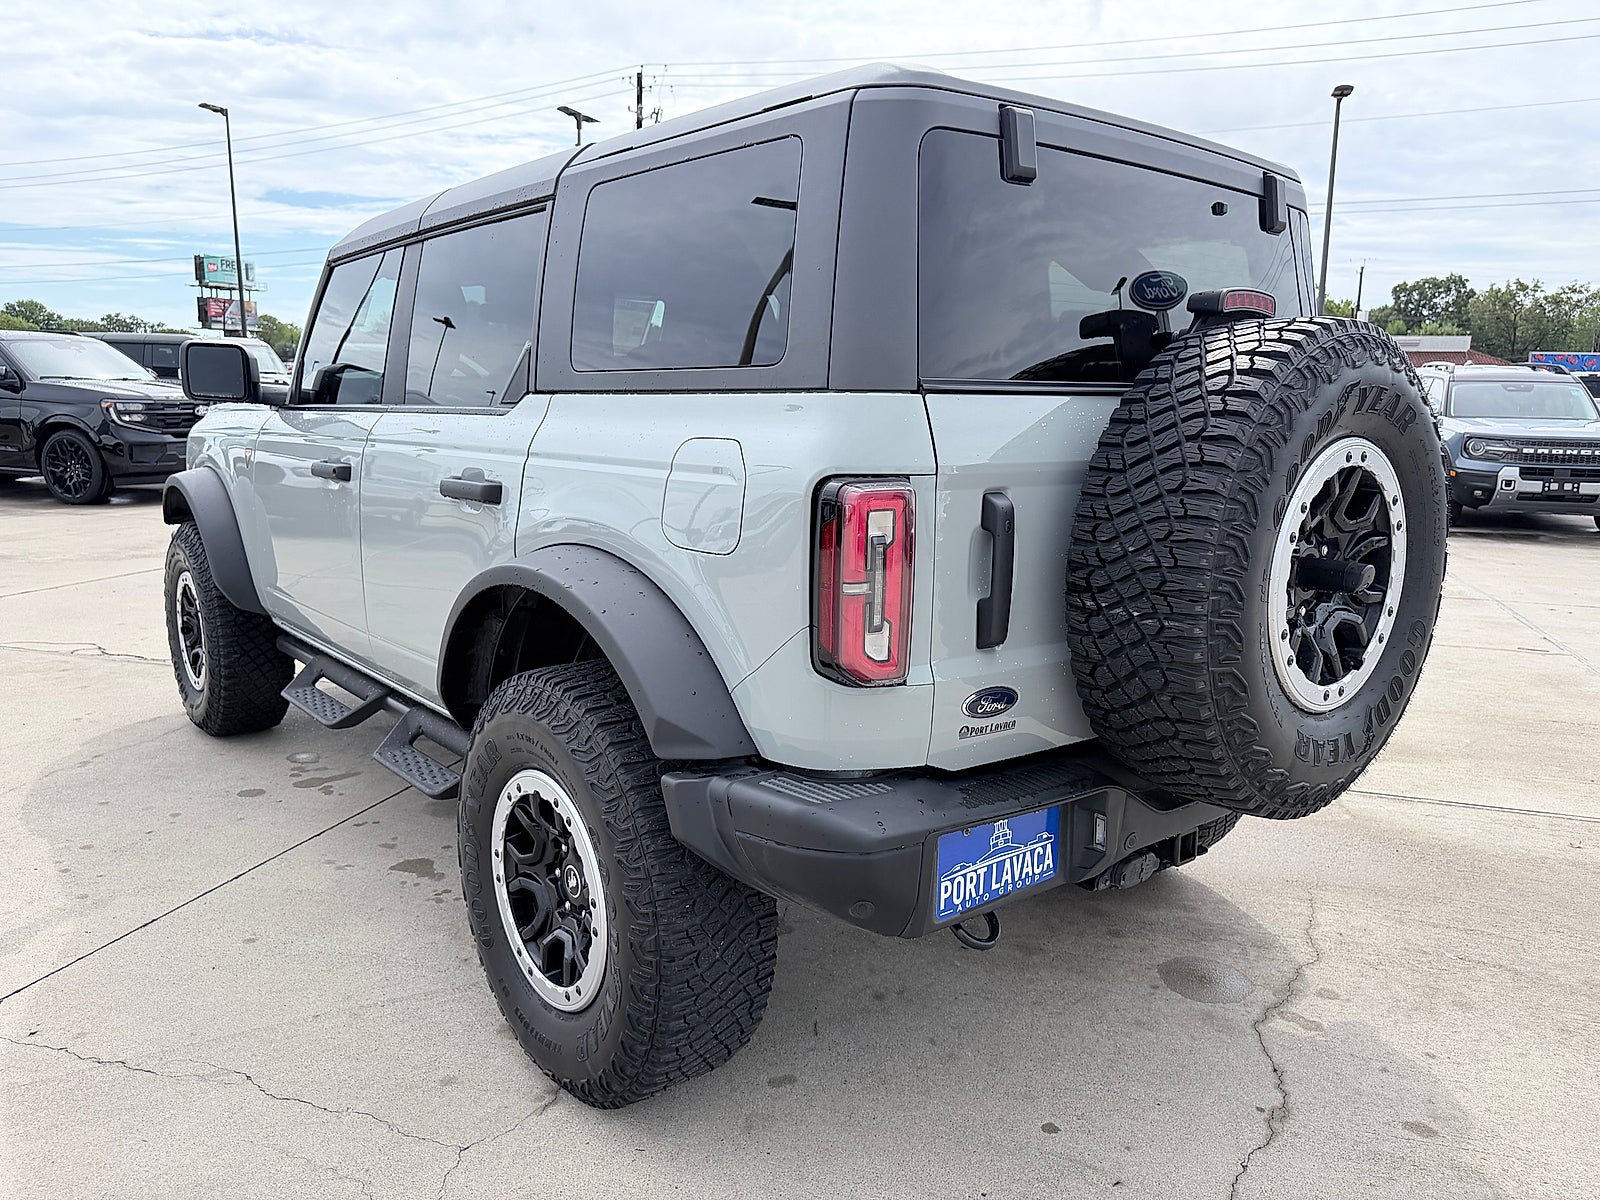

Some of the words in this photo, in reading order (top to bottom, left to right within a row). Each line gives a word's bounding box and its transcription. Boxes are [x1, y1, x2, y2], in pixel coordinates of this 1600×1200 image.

[220, 259, 237, 271] FRE
[970, 724, 988, 736] PORT
[990, 720, 1017, 732] LAVACA
[940, 866, 988, 910] PORT
[992, 843, 1054, 891] LAVACA
[956, 893, 990, 913] AUTO
[999, 875, 1040, 894] GROUP
